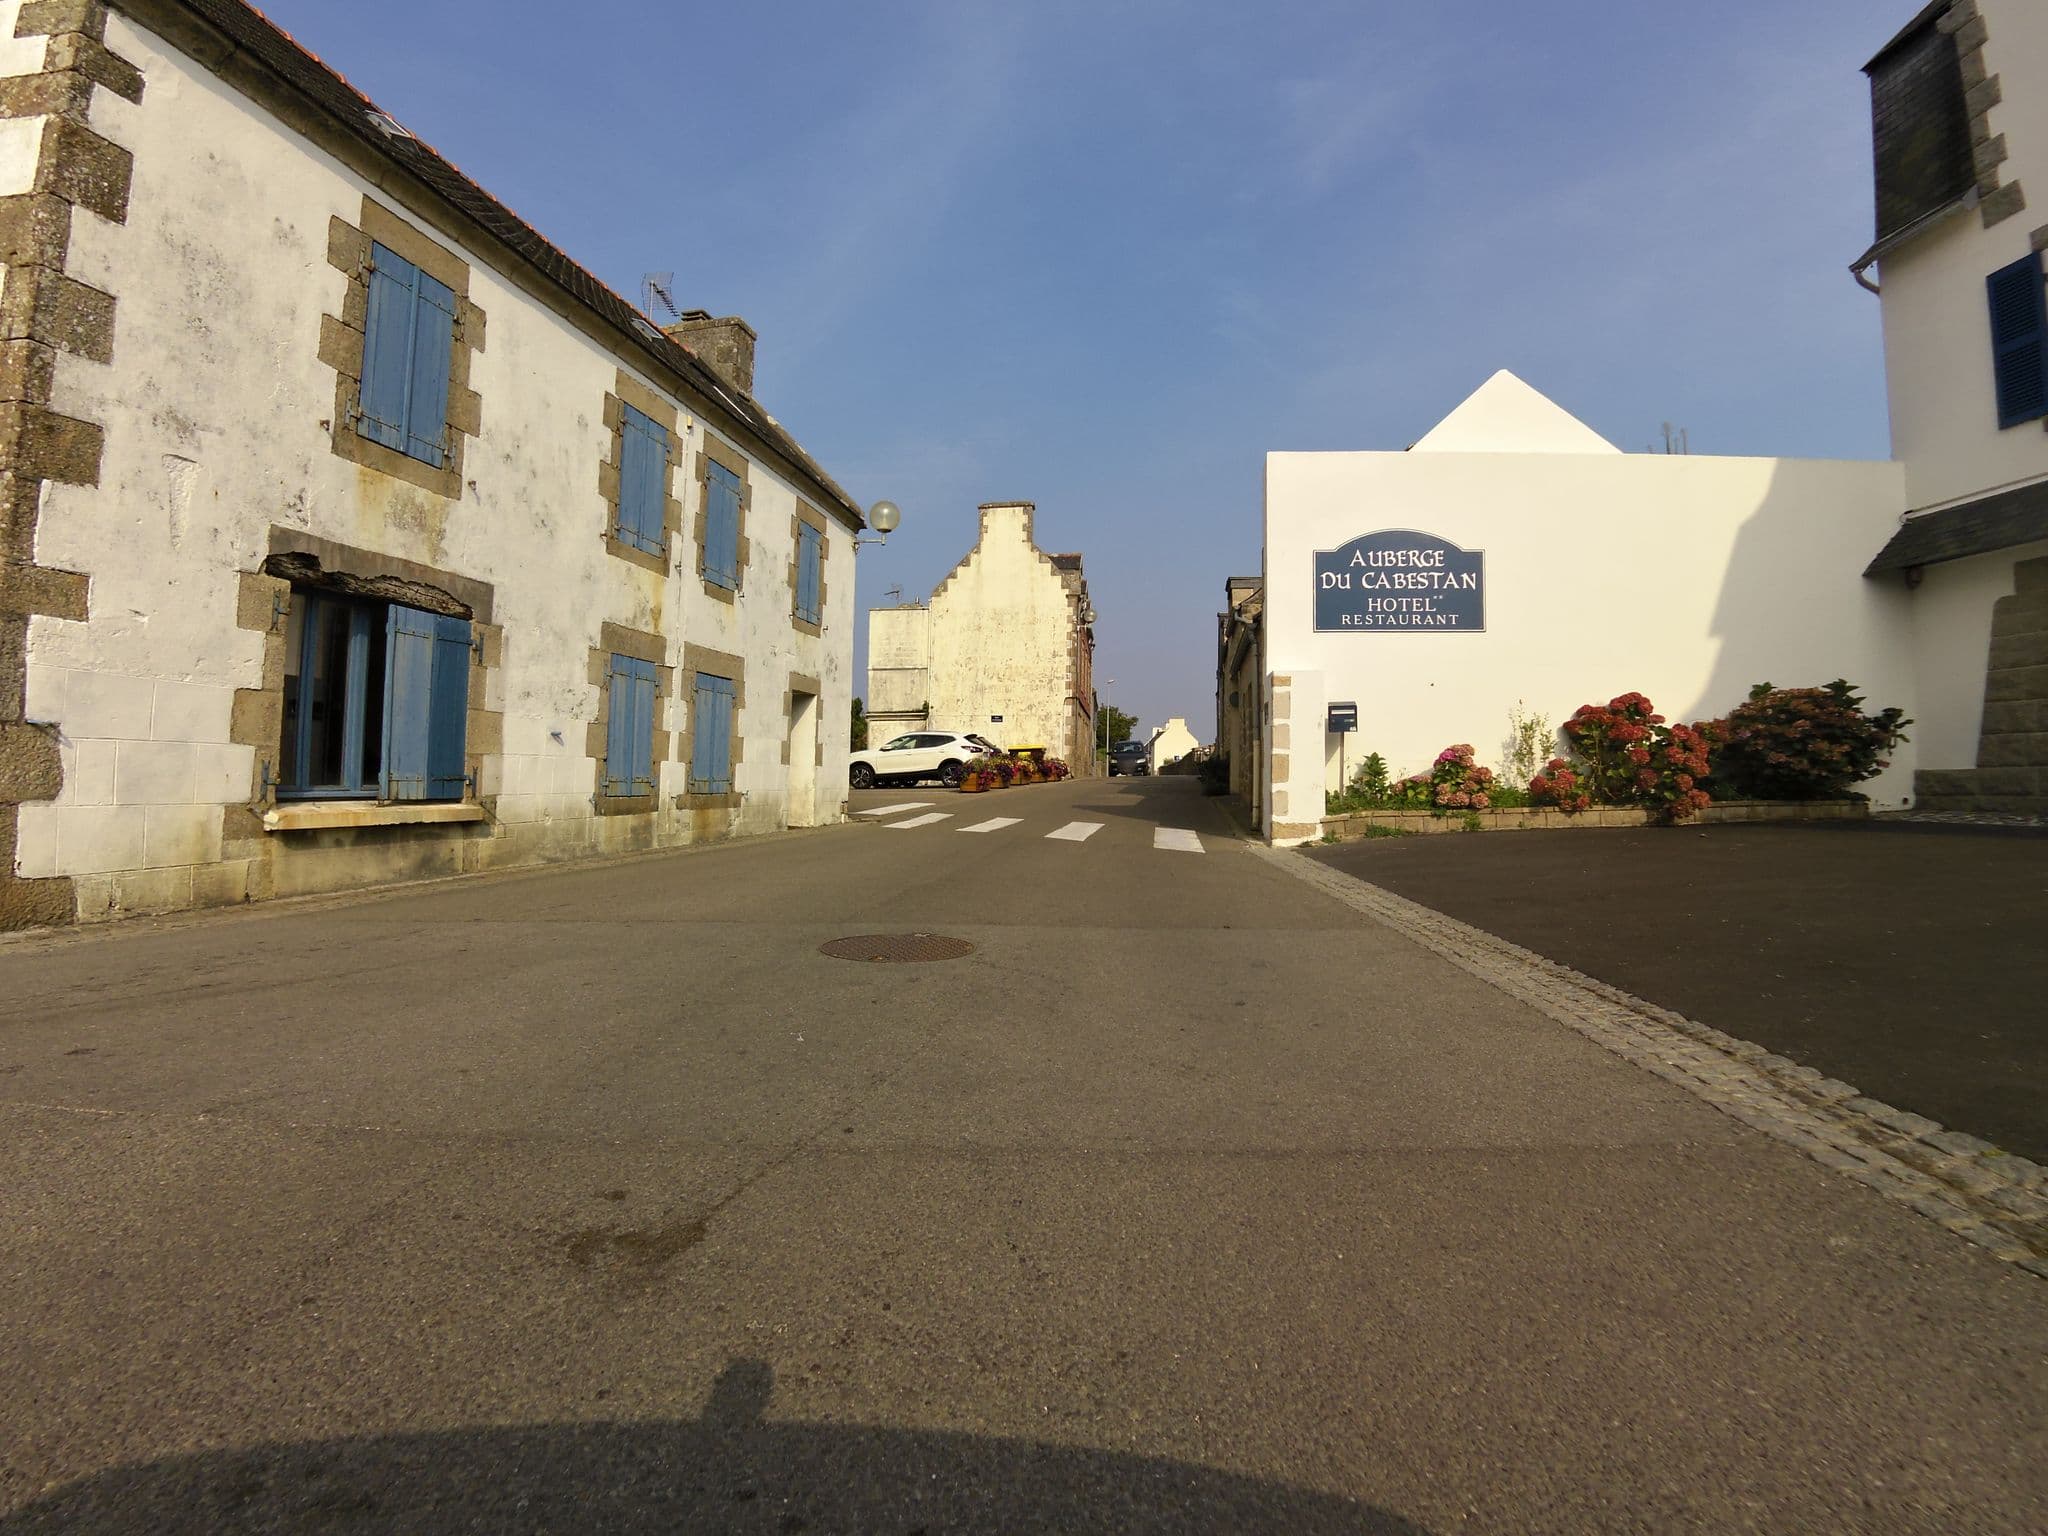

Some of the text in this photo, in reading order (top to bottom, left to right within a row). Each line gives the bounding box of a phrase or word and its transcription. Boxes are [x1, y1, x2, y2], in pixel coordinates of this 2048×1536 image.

[1350, 549, 1445, 568] AUBERGE
[1320, 572, 1477, 590] DU CABESTAN
[1367, 597, 1437, 612] HOTEL
[1341, 614, 1460, 625] RESTAURANT
